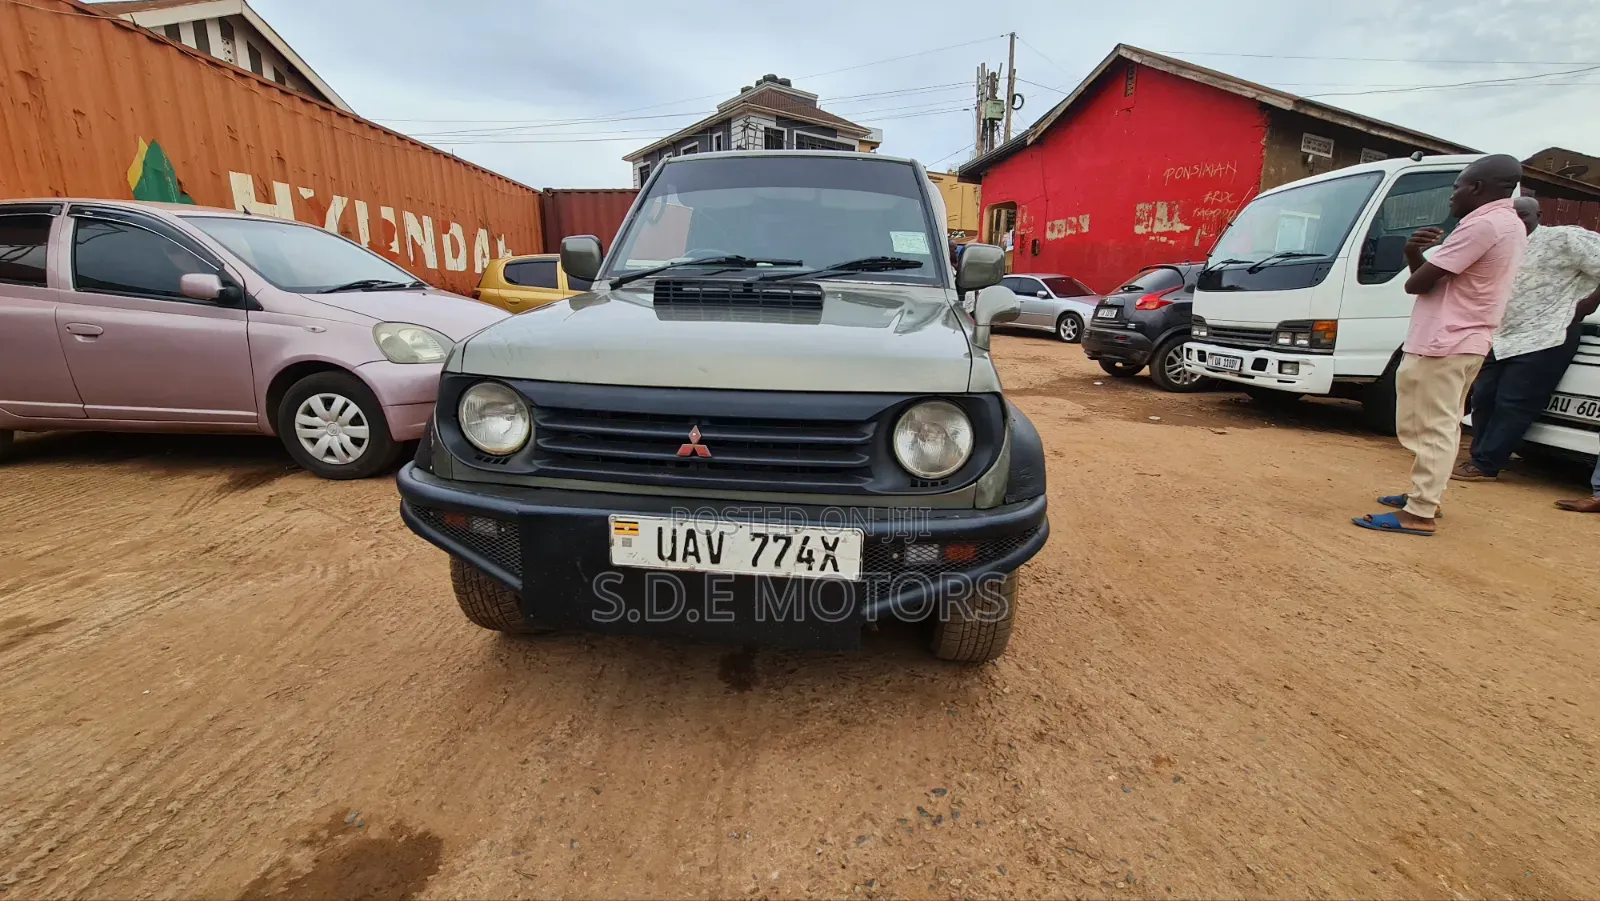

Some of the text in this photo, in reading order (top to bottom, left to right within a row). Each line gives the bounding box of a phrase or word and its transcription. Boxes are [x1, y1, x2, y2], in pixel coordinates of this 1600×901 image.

[1545, 396, 1571, 412] AU
[657, 526, 840, 573] UAV 774X
